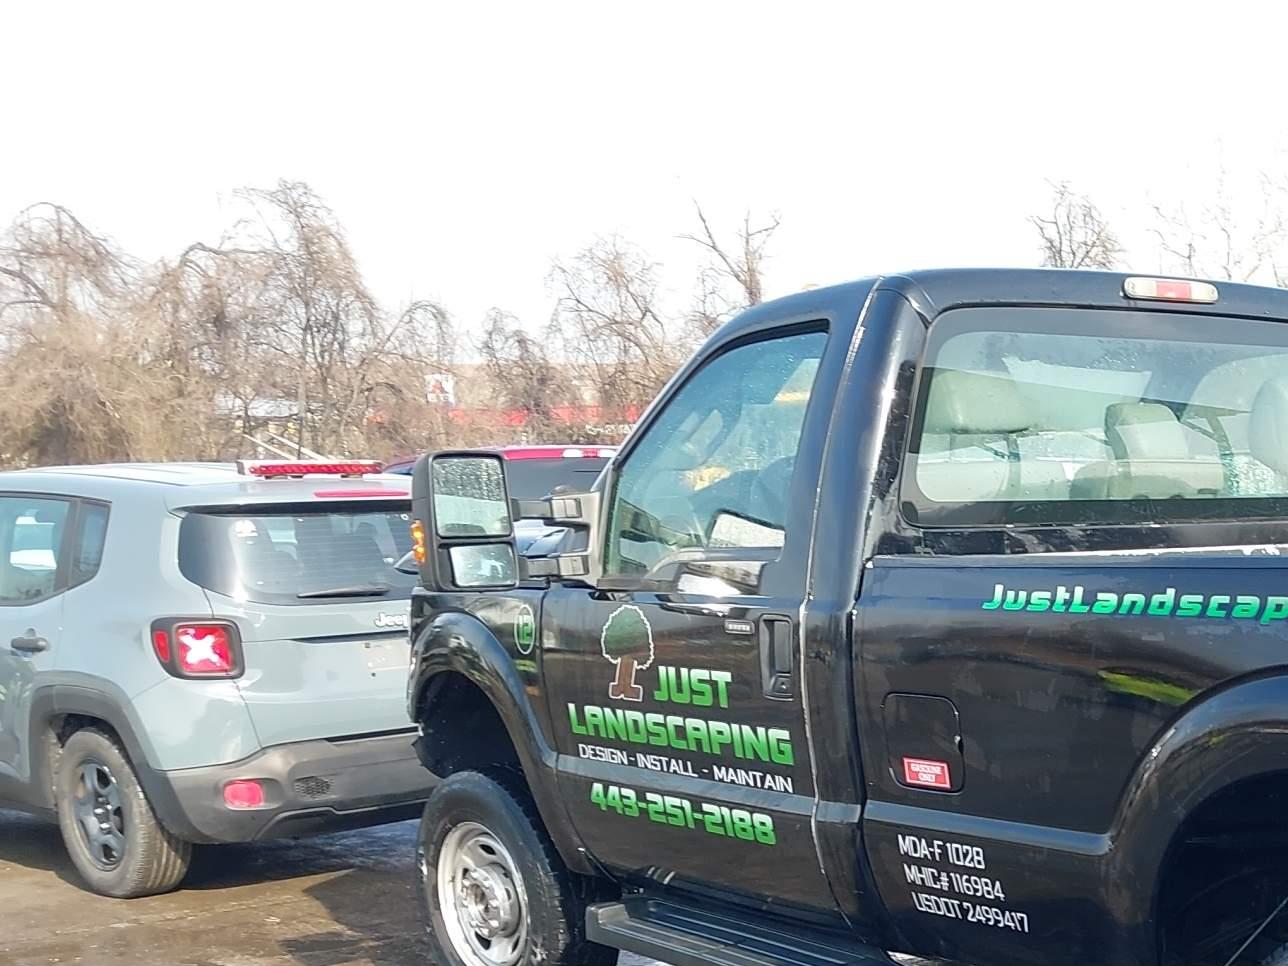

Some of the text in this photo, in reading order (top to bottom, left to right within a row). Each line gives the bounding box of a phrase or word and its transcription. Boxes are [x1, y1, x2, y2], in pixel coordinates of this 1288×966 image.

[653, 665, 733, 708] JUST
[567, 702, 795, 766] LANDSCAPING
[577, 743, 628, 767] DESIGN
[636, 753, 699, 778] INSTALL
[712, 764, 794, 794] MAINTAIN
[589, 782, 777, 846] 443-251-2188
[897, 834, 986, 869] MDA-F 1028
[911, 891, 1029, 933] USDOT 2499417
